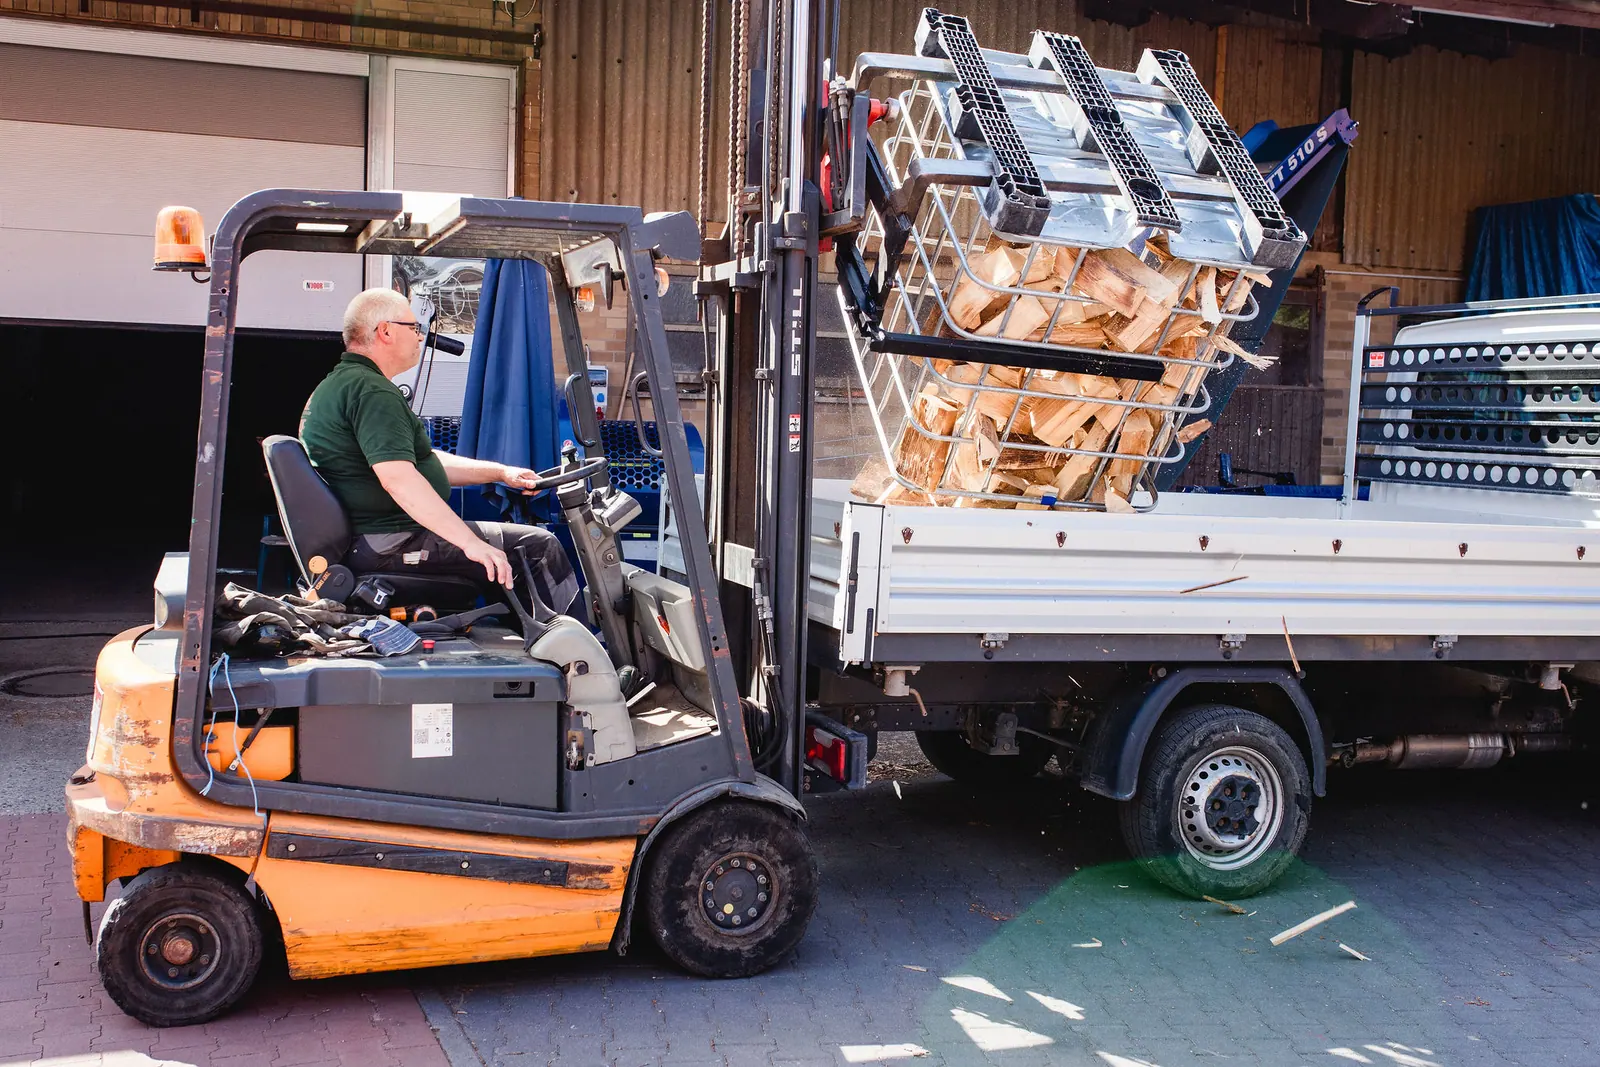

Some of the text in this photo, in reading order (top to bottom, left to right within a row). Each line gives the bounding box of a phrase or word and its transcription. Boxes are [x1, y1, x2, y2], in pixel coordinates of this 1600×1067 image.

[1287, 138, 1315, 171] 510
[1316, 126, 1328, 142] S
[791, 277, 803, 376] STILL
